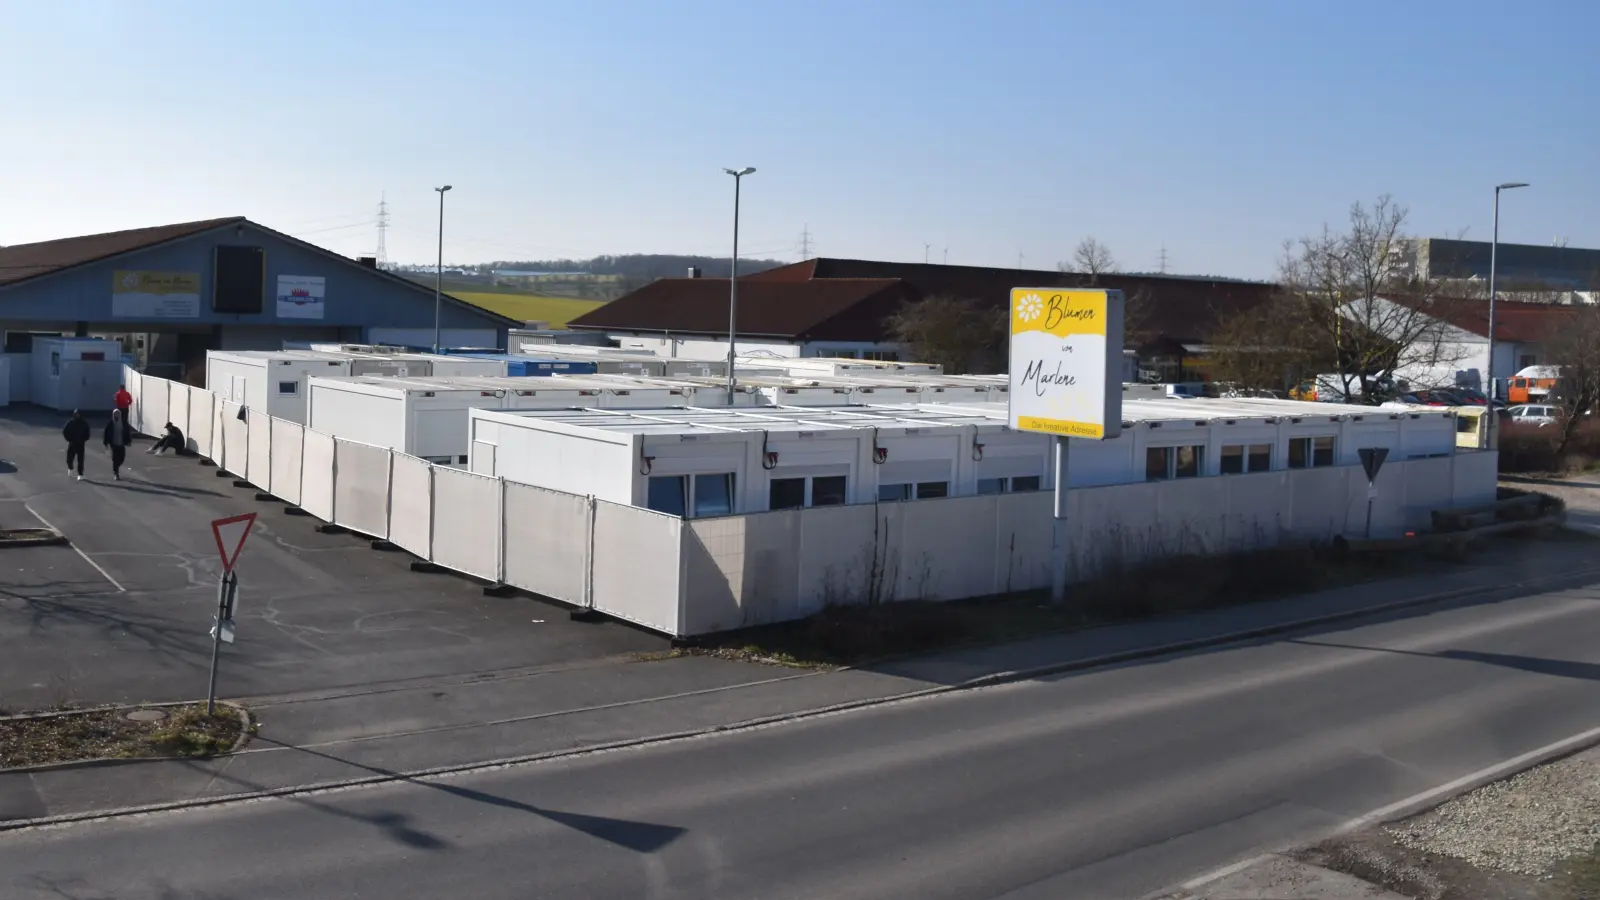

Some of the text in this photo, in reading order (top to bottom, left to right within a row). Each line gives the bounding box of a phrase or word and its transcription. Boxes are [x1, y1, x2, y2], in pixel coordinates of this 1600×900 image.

[1045, 294, 1096, 330] Blumen
[1021, 359, 1076, 397] Marlene
[1043, 422, 1069, 433] kreative
[1070, 424, 1097, 436] Adresse
